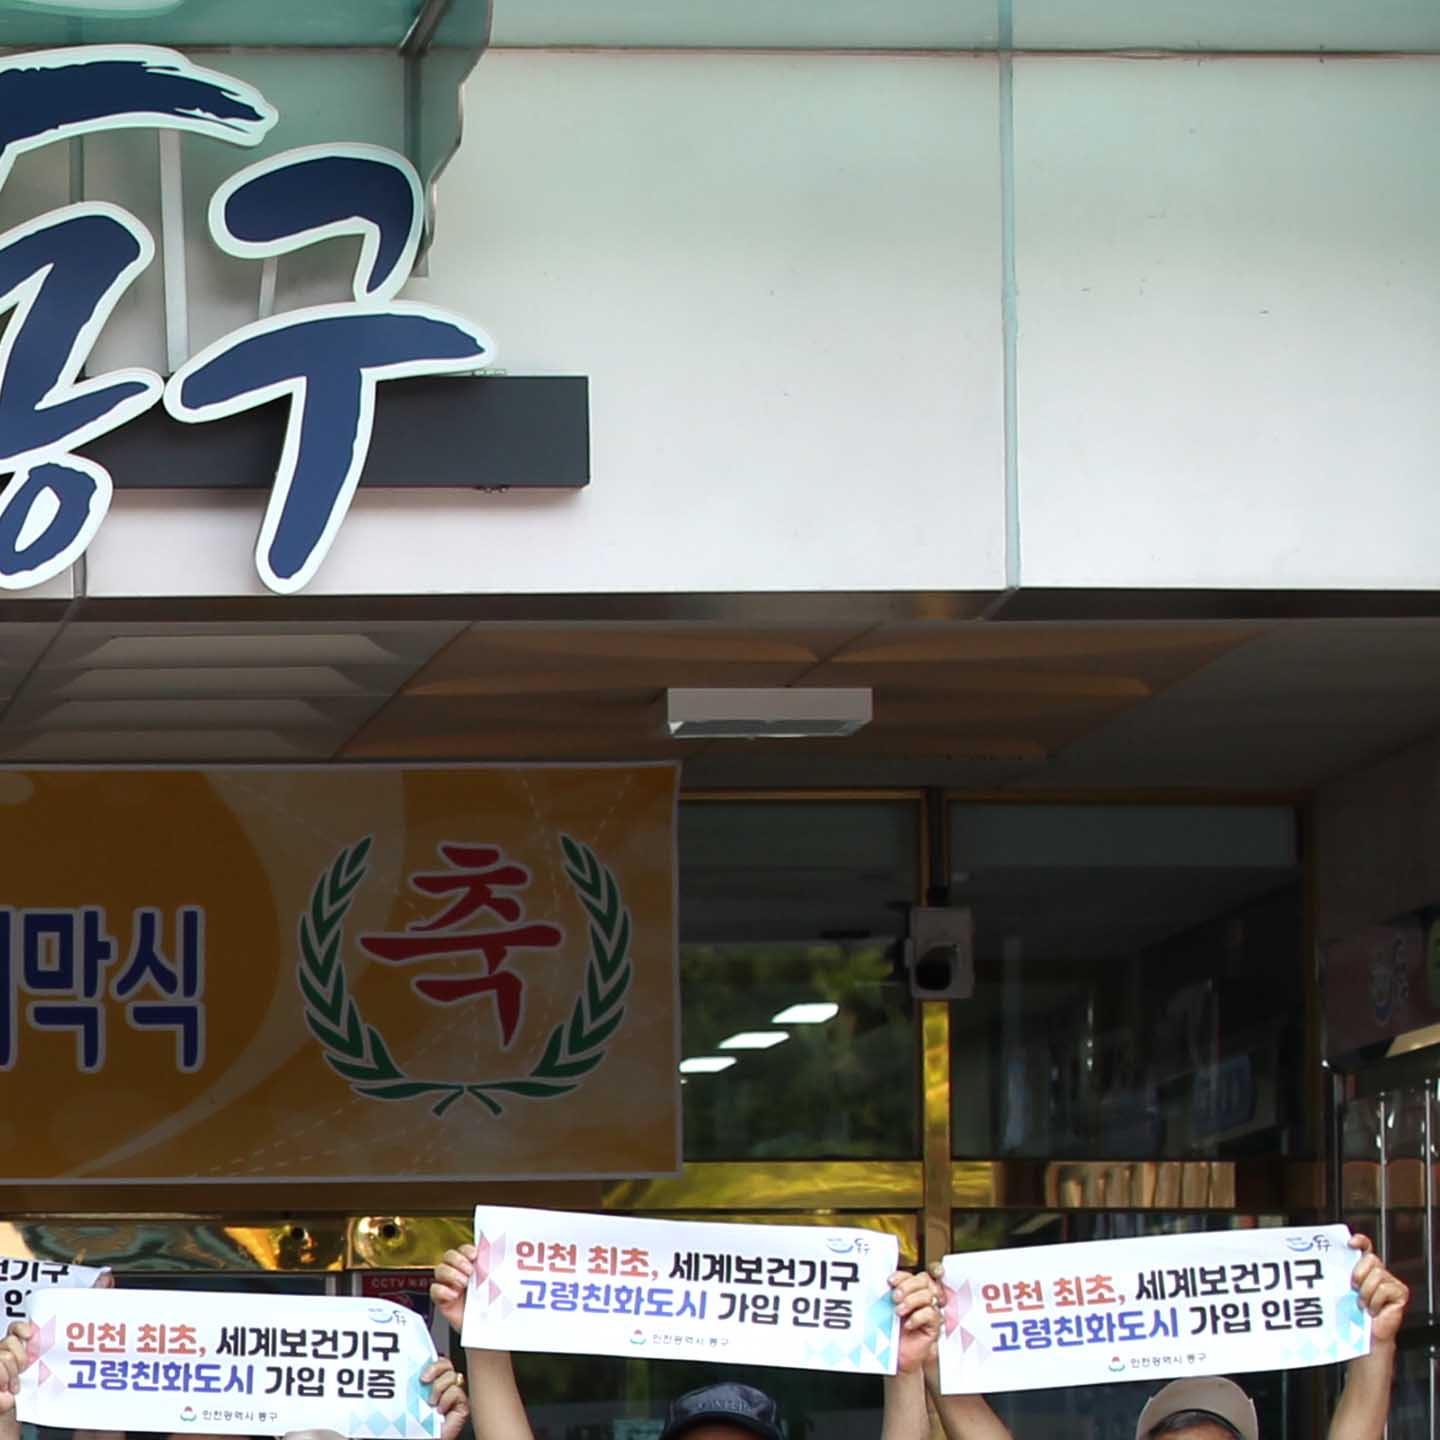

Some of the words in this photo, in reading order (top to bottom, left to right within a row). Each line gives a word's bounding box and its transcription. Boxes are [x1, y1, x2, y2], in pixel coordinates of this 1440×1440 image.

[360, 842, 562, 1050] 축
[516, 1241, 576, 1273] 인천
[588, 1246, 658, 1280] 최초,
[669, 1252, 860, 1291] 세계보건기구
[982, 1280, 1044, 1313] 인천
[1053, 1275, 1125, 1307] 최초,
[1136, 1259, 1324, 1300] 세계보건기구
[517, 1280, 706, 1319] 고령친화도시
[718, 1293, 780, 1325] 가입
[792, 1297, 852, 1329] 인증
[991, 1307, 1178, 1351] 고령친화도시
[1189, 1302, 1251, 1335] 가입
[1262, 1297, 1323, 1330] 인증
[66, 1323, 126, 1353] 인천
[136, 1324, 206, 1357] 최초,
[216, 1326, 400, 1362] 세계보건기구
[68, 1360, 253, 1394] 고령친화도시
[265, 1366, 325, 1397] 가입
[337, 1368, 395, 1399] 인증
